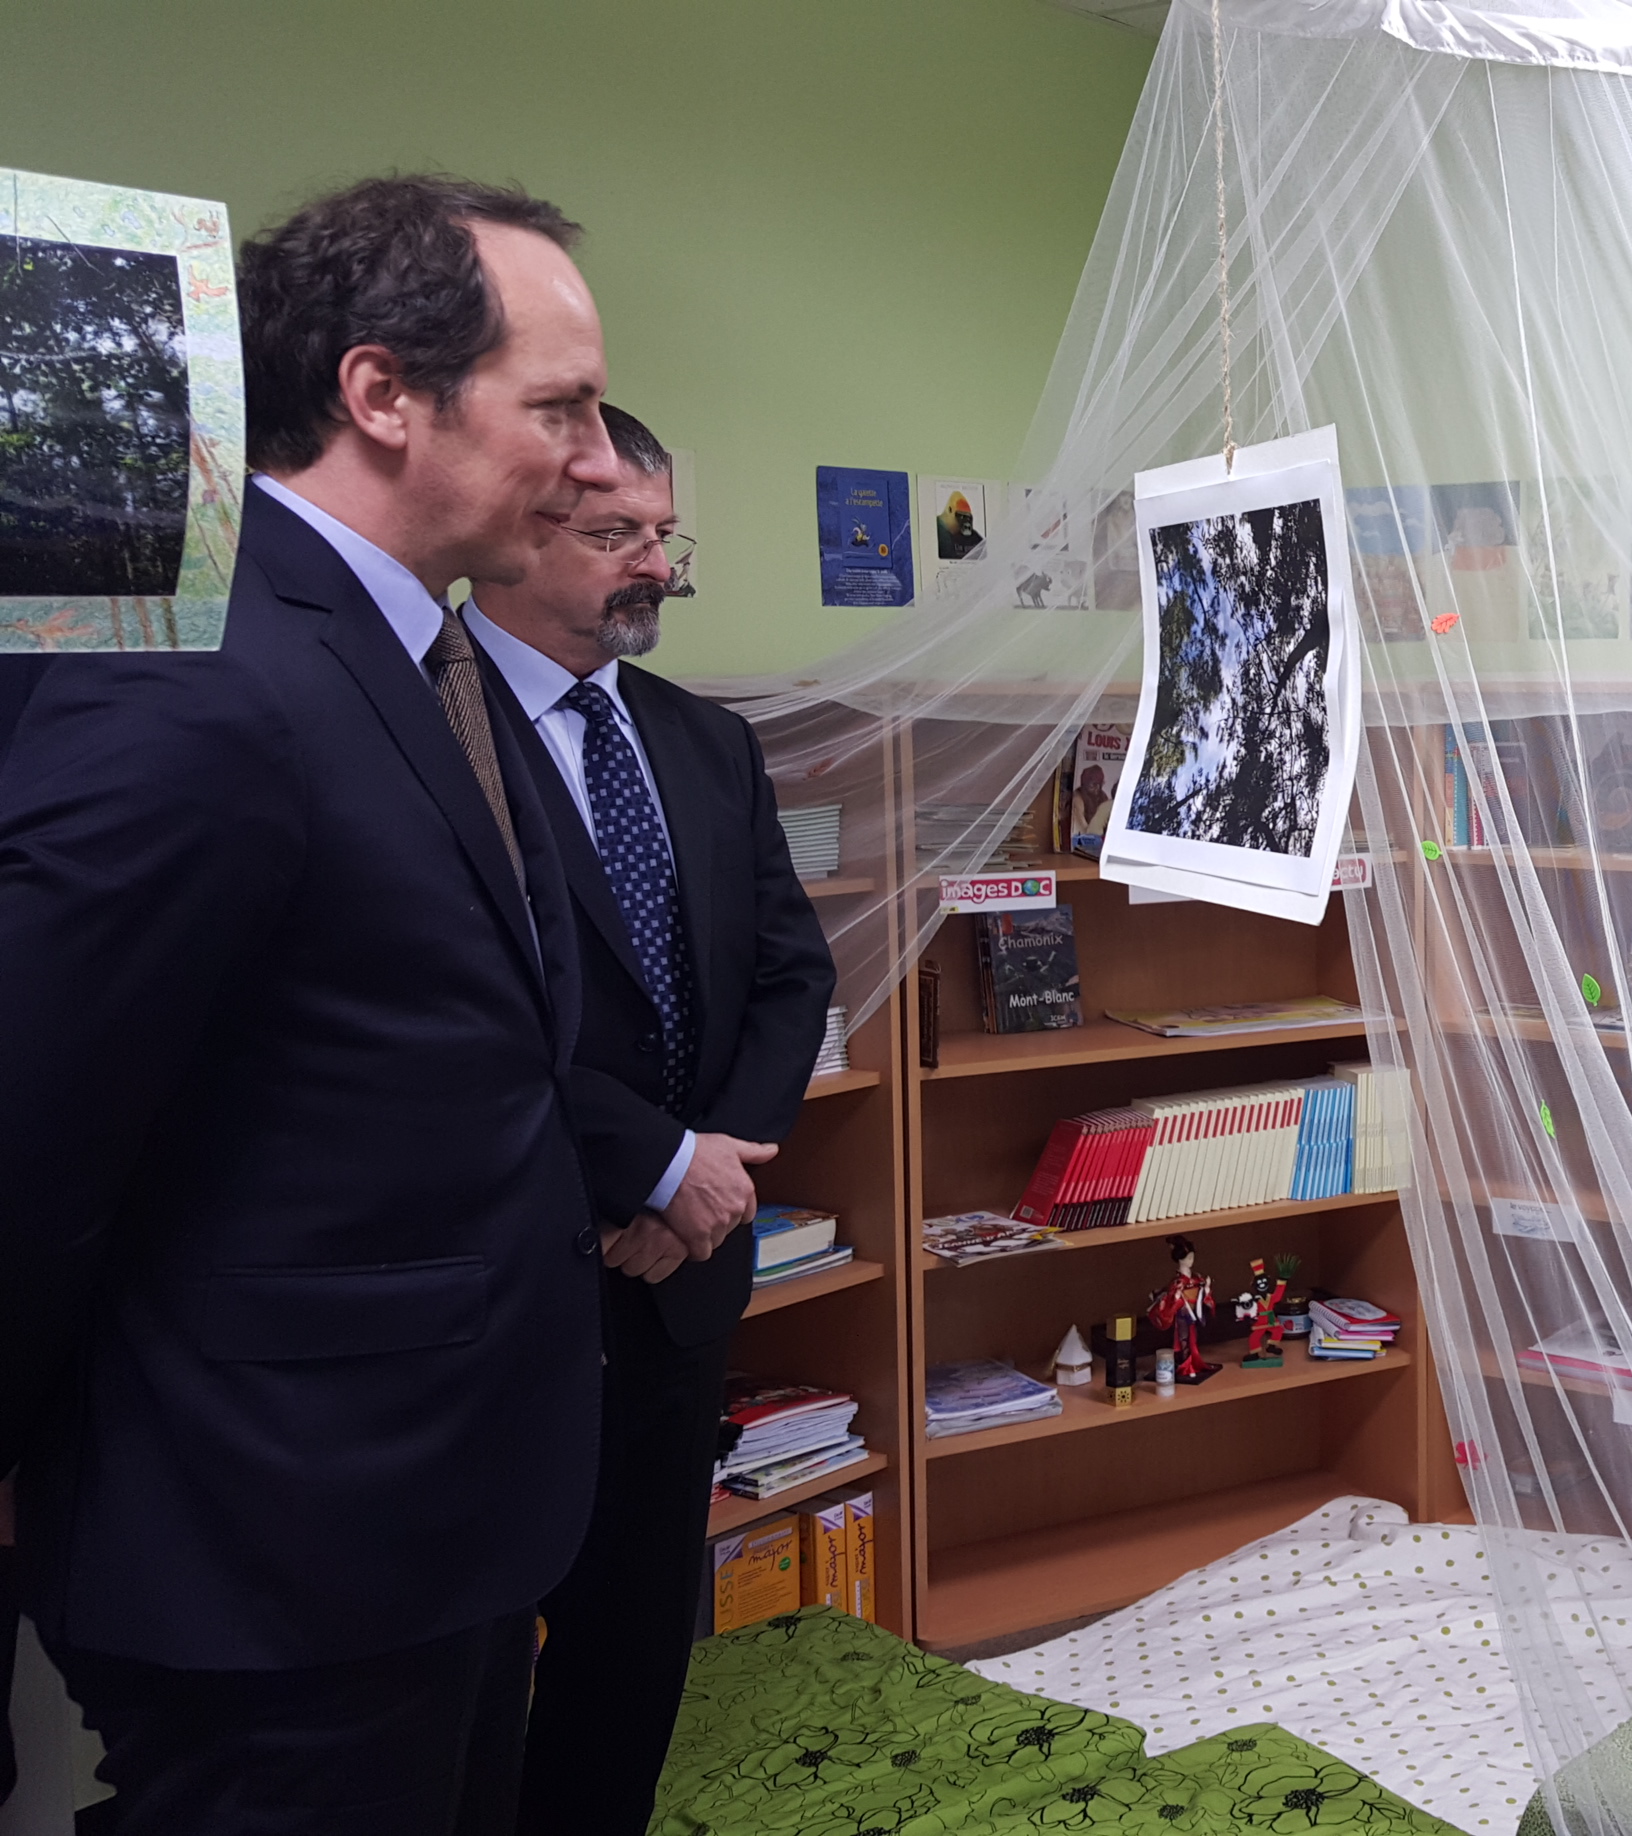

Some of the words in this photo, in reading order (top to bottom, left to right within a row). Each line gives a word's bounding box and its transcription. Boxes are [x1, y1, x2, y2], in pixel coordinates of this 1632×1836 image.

[1087, 731, 1122, 751] LOUIS
[941, 879, 1008, 904] images
[998, 932, 1063, 949] Chamonix
[1009, 990, 1075, 1008] Mont-Blanc
[748, 1540, 793, 1571] major
